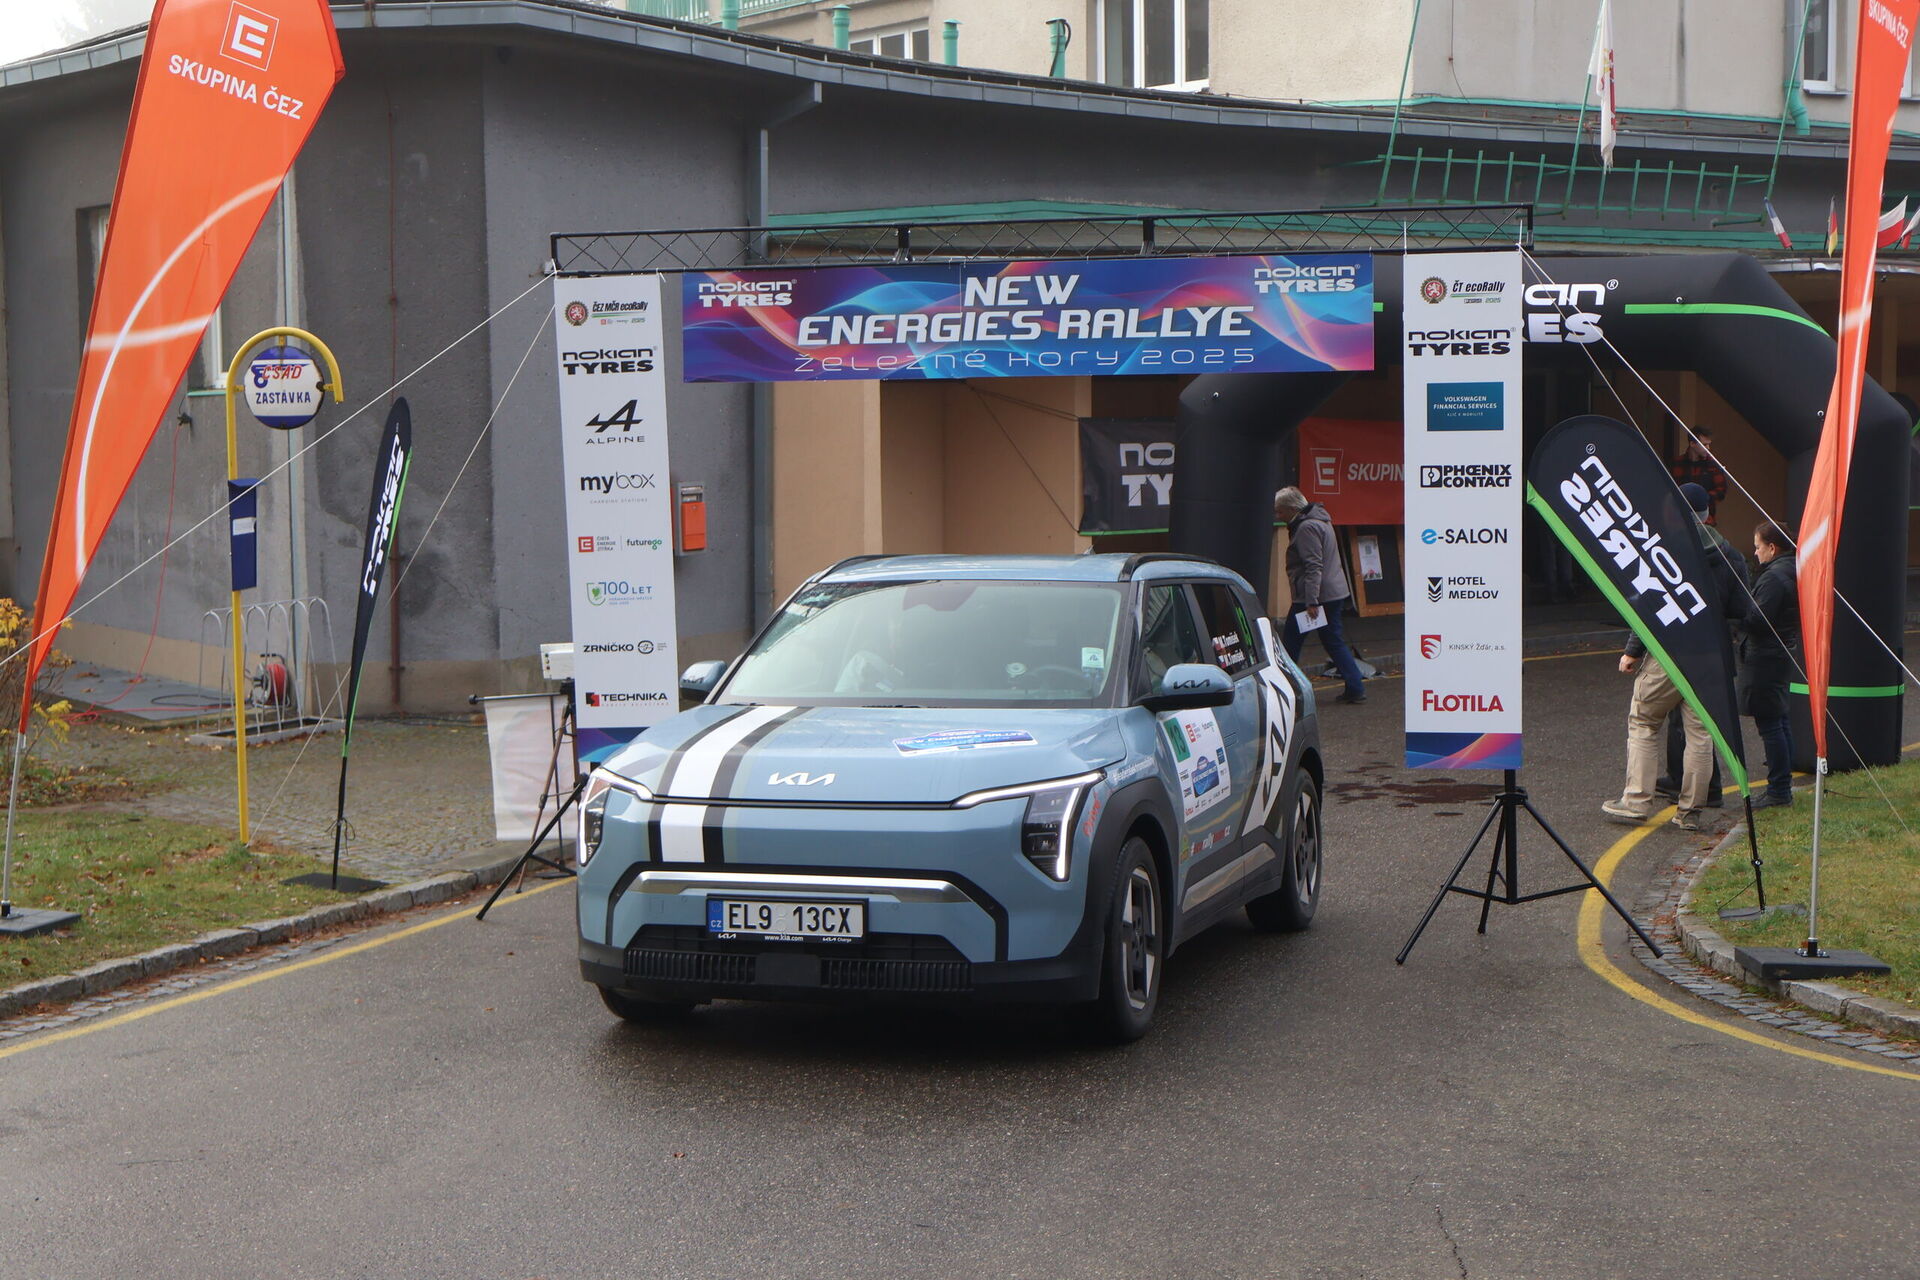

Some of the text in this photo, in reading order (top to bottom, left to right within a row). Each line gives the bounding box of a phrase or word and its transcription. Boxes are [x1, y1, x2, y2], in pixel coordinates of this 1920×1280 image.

[168, 54, 304, 120] SKUPINA ČEZ
[1254, 265, 1356, 279] nokian
[698, 279, 792, 293] nokian
[964, 274, 1080, 307] NEW
[1254, 278, 1356, 294] TYRES
[1452, 280, 1505, 293] ČT ecoRally
[592, 301, 604, 312] ČEZ
[699, 292, 793, 308] TYRES
[797, 306, 1255, 346] ENERGIES RALLYE
[1408, 329, 1511, 341] nokian
[563, 348, 653, 361] nokian
[1408, 342, 1511, 356] TYRES
[1141, 348, 1255, 365] 2025
[563, 360, 654, 375] TYRES
[256, 389, 311, 404] ZASTÁVKA
[586, 435, 645, 445] ALPINE
[580, 471, 656, 494] mybox
[1443, 476, 1512, 488] CONTACT
[1420, 528, 1508, 545] e-SALON
[626, 538, 663, 550] futurego
[1448, 576, 1486, 586] HOTEL
[632, 586, 653, 594] LET
[1448, 590, 1499, 599] MEDLOV
[583, 641, 634, 653] ZRNÍČKO
[1449, 643, 1474, 651] KINSKÝ
[601, 692, 668, 702] TECHNIKA
[767, 771, 836, 787] KIA
[710, 919, 722, 928] CZ
[728, 903, 850, 933] EL9 13CX
[764, 933, 804, 942] www.kia.com
